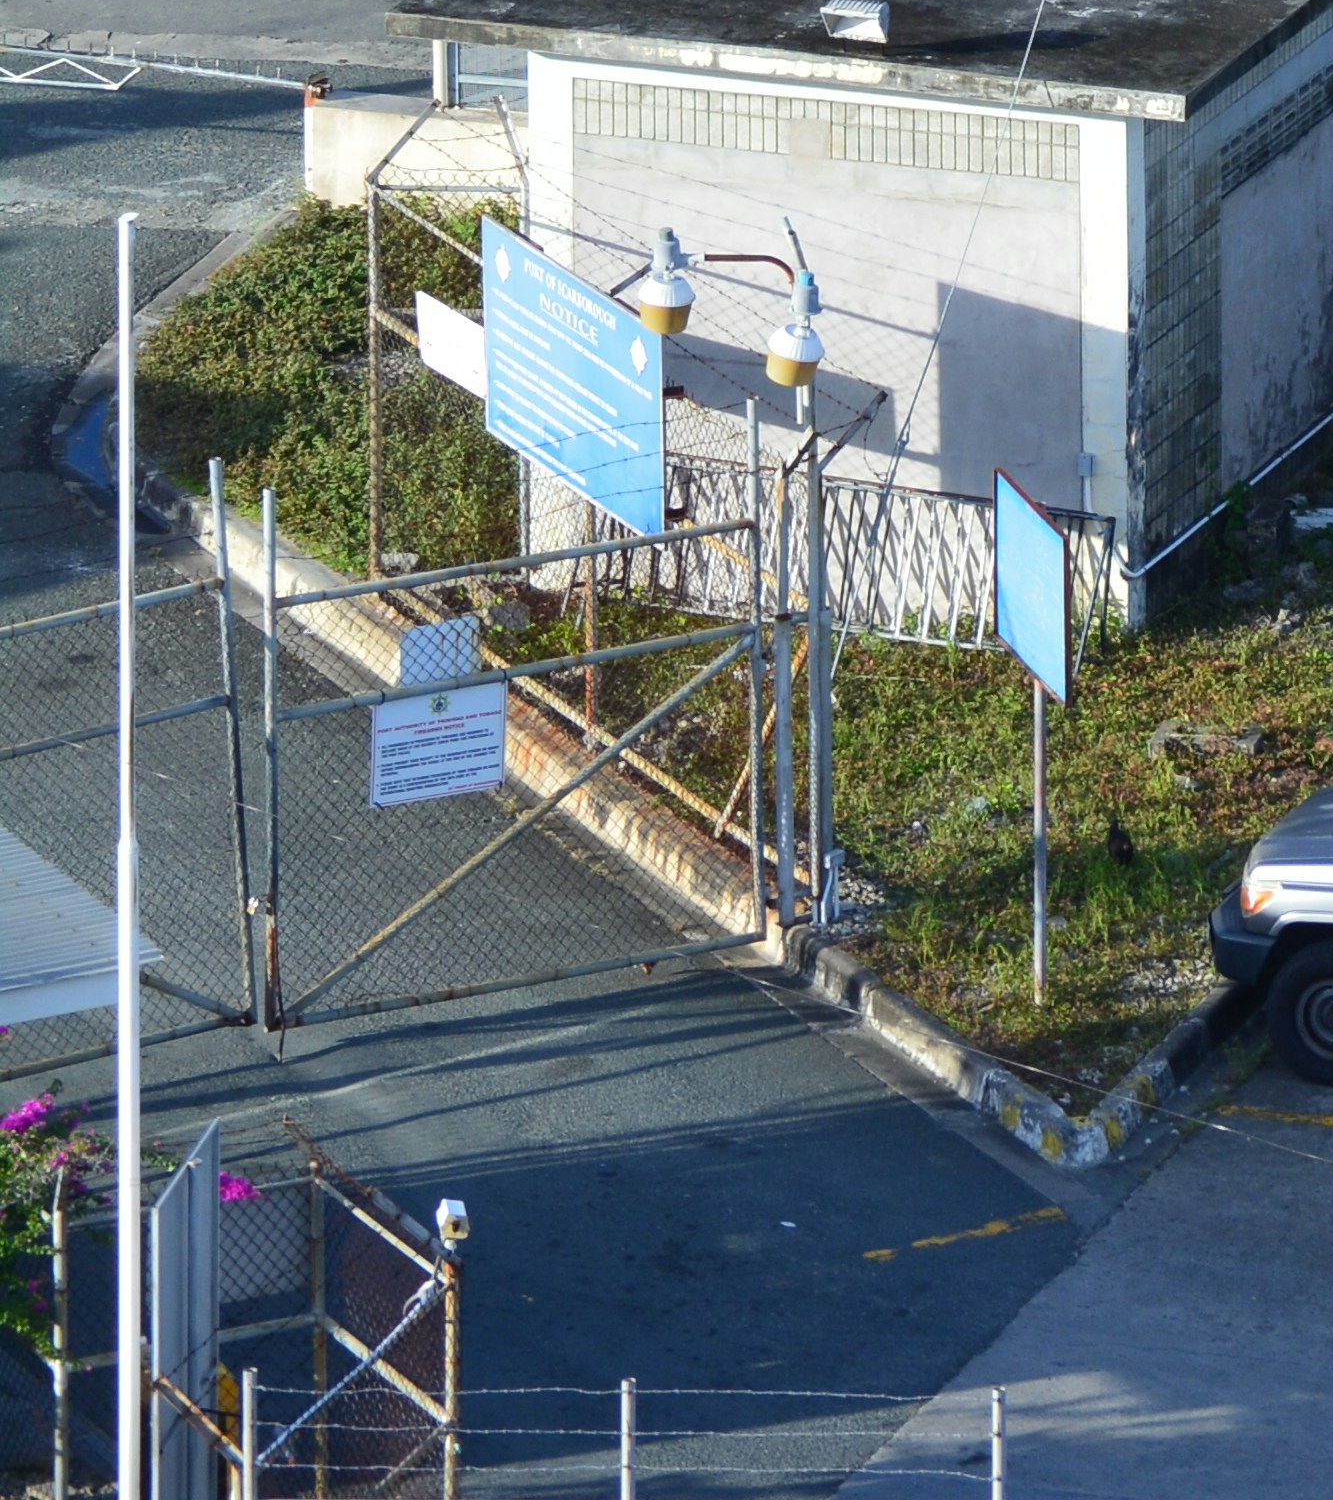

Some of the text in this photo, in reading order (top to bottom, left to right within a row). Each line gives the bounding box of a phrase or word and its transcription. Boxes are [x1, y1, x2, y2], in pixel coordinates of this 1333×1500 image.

[524, 257, 617, 331] PORT OF SCARBOROUGH
[539, 292, 599, 341] NOTICE
